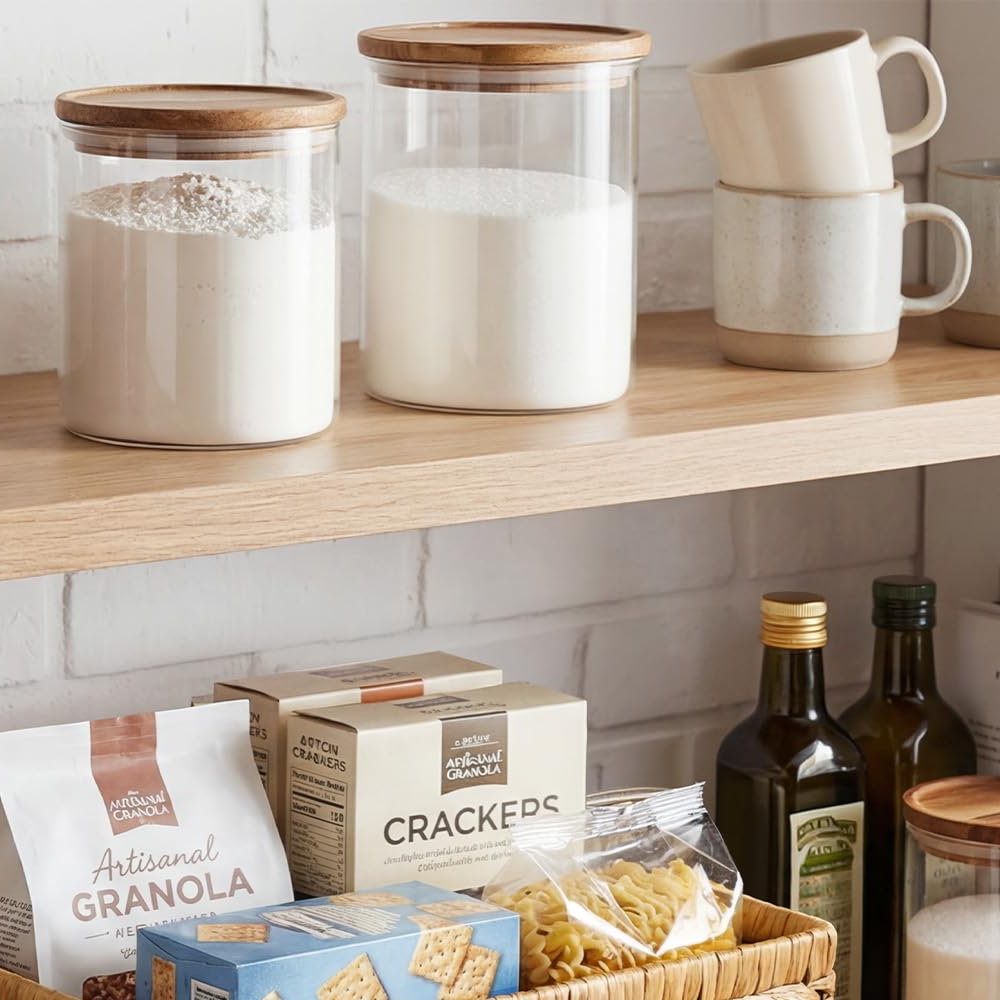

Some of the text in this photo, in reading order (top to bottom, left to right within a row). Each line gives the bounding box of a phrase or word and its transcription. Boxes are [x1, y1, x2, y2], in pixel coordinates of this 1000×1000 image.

[383, 794, 560, 846] CRACKERS
[92, 833, 220, 884] Artisanal
[71, 867, 255, 922] GRANOLA
